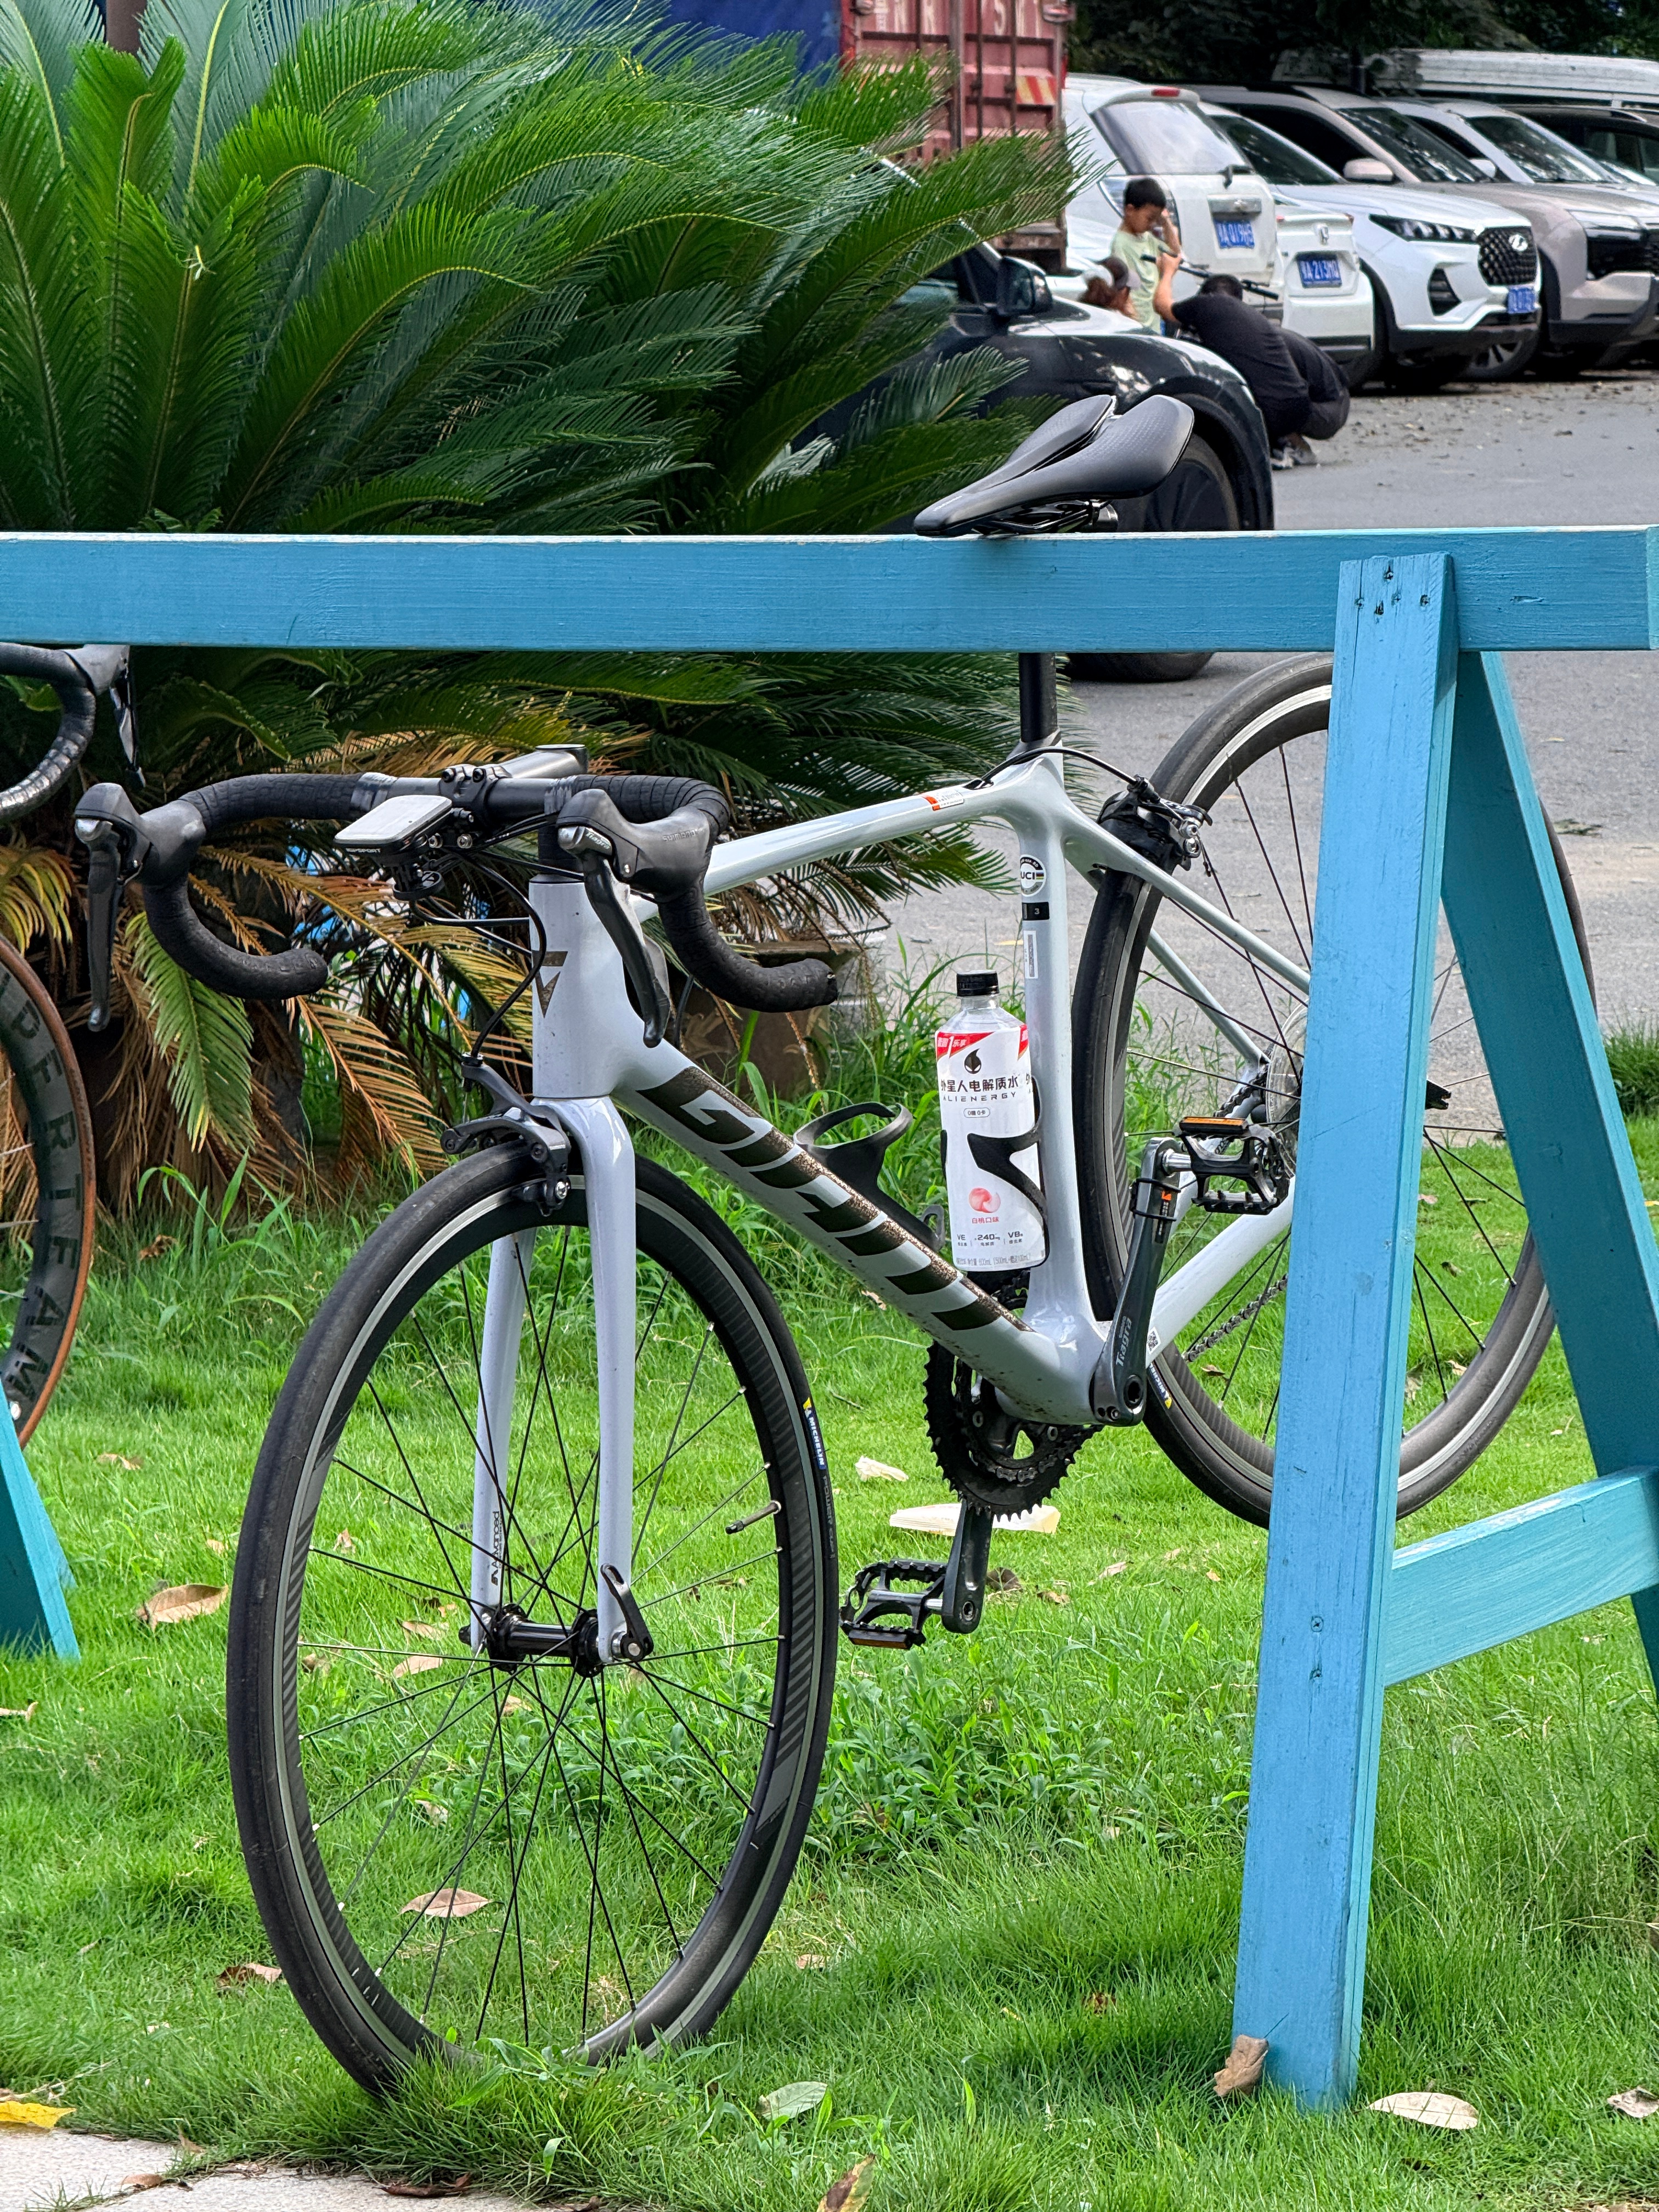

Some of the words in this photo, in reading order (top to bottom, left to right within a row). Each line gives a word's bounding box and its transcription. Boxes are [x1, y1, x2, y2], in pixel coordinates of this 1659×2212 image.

[585, 831, 610, 849] Tiagra
[663, 829, 702, 842] SHIMANO
[1020, 871, 1035, 880] UCI
[940, 1075, 1019, 1093] 外星人电解质水
[943, 1091, 1016, 1102] ALIENERGY
[637, 1066, 1036, 1332] GIANT
[1115, 1317, 1132, 1367] Tiagra
[808, 1417, 825, 1465] MICHELIN
[492, 1511, 500, 1569] Advanced
